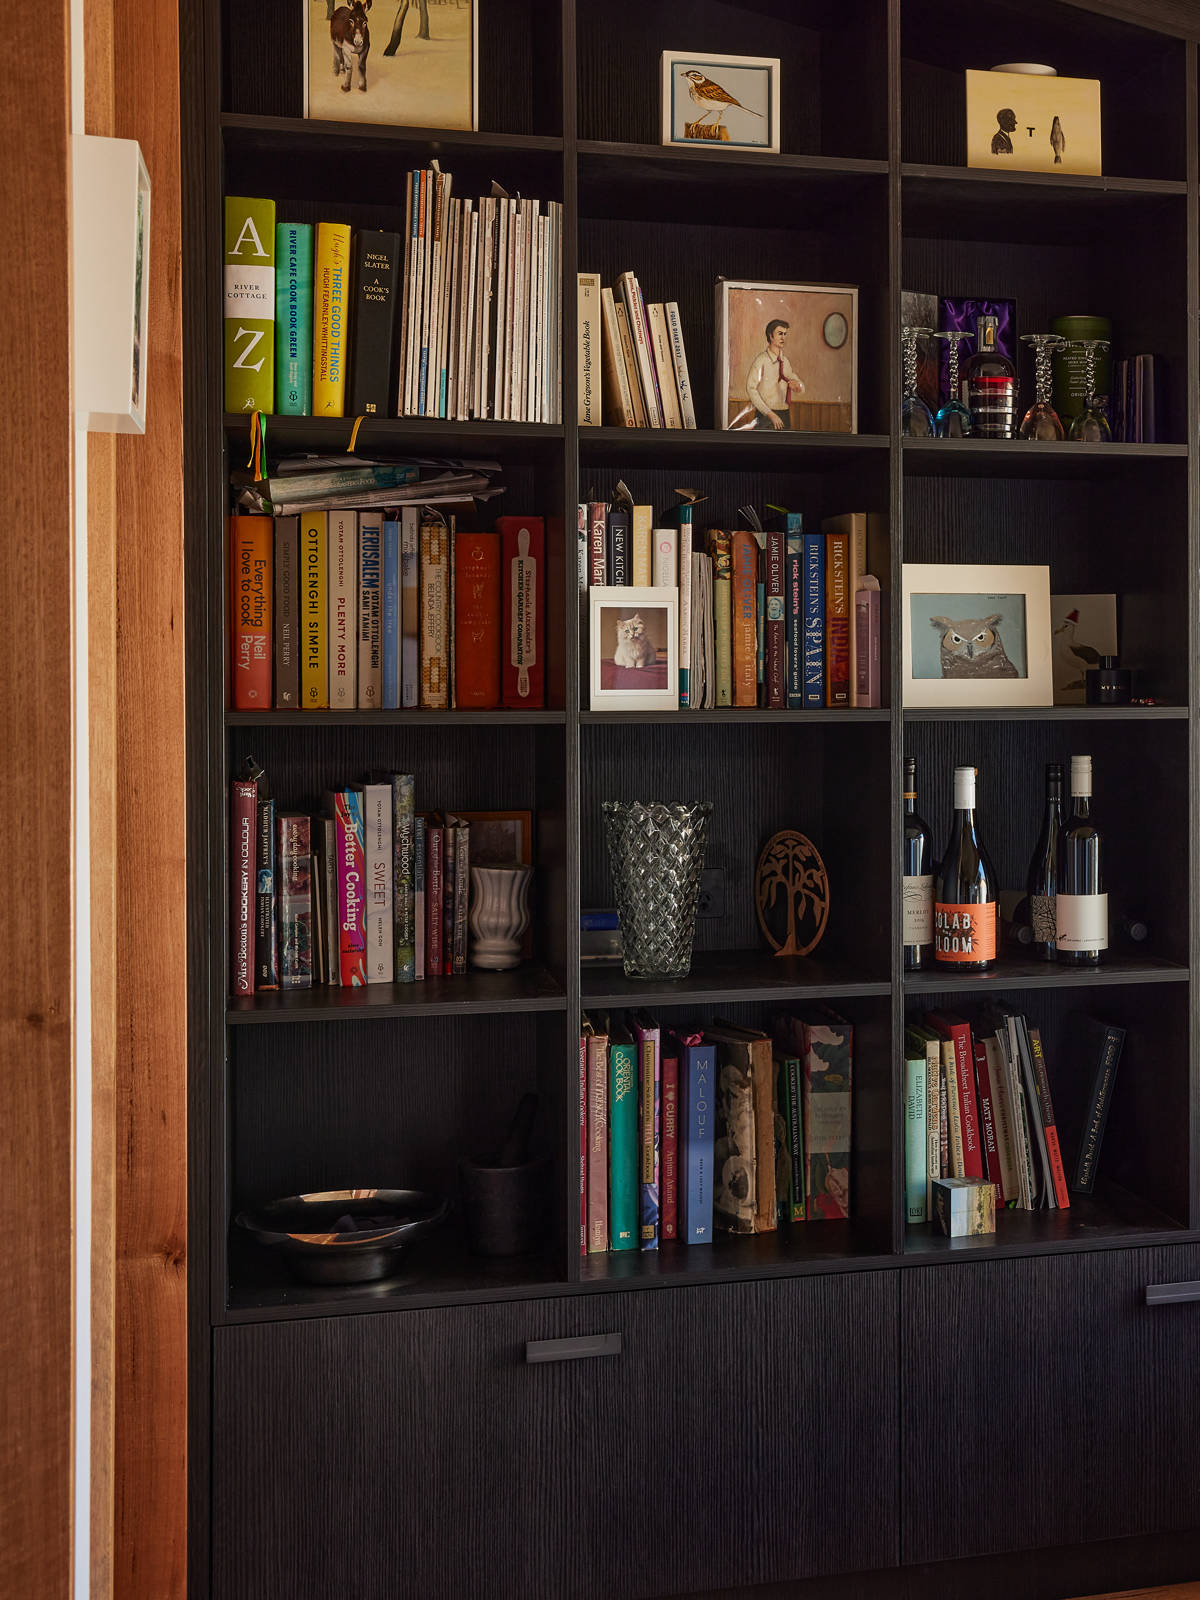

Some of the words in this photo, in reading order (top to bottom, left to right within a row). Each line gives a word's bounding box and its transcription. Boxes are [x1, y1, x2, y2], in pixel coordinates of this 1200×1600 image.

[1026, 127, 1036, 137] T
[228, 217, 271, 257] A
[289, 229, 298, 254] RIVER
[330, 233, 345, 265] Hugh's
[289, 257, 298, 278] CAFE
[364, 261, 391, 270] SLATER
[367, 253, 389, 262] NIGEL
[234, 284, 261, 292] RIVER
[289, 280, 298, 303] COOK
[322, 267, 331, 288] HUGH
[332, 267, 343, 302] THREE
[364, 285, 390, 294] COOK'S
[374, 278, 380, 286] A
[227, 292, 267, 300] COTTAGE
[365, 294, 386, 302] BOOK
[289, 305, 298, 329] BOOK
[331, 305, 342, 338] GOOD
[583, 320, 591, 340] Book
[232, 326, 265, 373] Z
[289, 330, 298, 358] GREEN
[320, 290, 330, 382] FEARNLEY-WHITTINGSTALL
[330, 341, 341, 383] THINGS
[582, 340, 592, 372] Vegetable
[582, 373, 592, 406] Grigson's
[583, 406, 593, 424] Jane
[593, 520, 605, 554] Karen
[615, 529, 624, 553] NEW
[771, 536, 779, 562] JAMIE
[241, 549, 254, 575] love
[361, 525, 380, 589] JERUSALEM
[742, 543, 753, 577] JAMIE
[809, 544, 820, 569] RICK
[833, 541, 843, 569] RICK
[282, 570, 291, 594] GOOD
[308, 528, 319, 615] OTTOLENGHI
[771, 563, 779, 593] OLIVER
[792, 559, 800, 580] rick
[241, 578, 252, 592] to
[252, 560, 267, 628] Everything
[427, 583, 435, 611] BELINDA
[792, 581, 800, 615] stein's
[809, 571, 820, 614] STEIN'S
[833, 570, 844, 614] STEIN'S
[241, 595, 253, 627] cook
[282, 596, 291, 618] FOOD
[362, 590, 371, 610] SAMI
[371, 590, 380, 618] YOTAM
[742, 580, 753, 620] OLIVER
[283, 623, 292, 641] NEIL
[337, 598, 346, 641] PLENTY
[361, 613, 371, 641] TAMIMI
[427, 612, 435, 639] JEFFERY
[238, 635, 254, 671] Perry
[254, 635, 267, 660] Neil
[283, 642, 292, 667] PERRY
[308, 622, 319, 670] SIMPLE
[370, 619, 380, 670] OTTOLENGHI
[742, 622, 754, 660] jamie's
[805, 617, 824, 686] SPAIN
[830, 617, 849, 665] INDIA
[337, 644, 346, 676] MORE
[741, 664, 754, 688] italy
[791, 671, 799, 690] guide
[262, 806, 270, 833] MADHUR
[261, 834, 269, 866] JAFFREY'S
[344, 823, 358, 868] Better
[400, 824, 412, 875] Wychwood
[242, 860, 249, 870] IN
[241, 871, 249, 921] COOKERY
[374, 862, 386, 907] SWEET
[343, 871, 360, 932] Cooking
[236, 923, 249, 959] Beeton's
[957, 1034, 967, 1050] The
[615, 1051, 624, 1077] COOK
[623, 1057, 632, 1094] ORIENTAL
[958, 1050, 969, 1090] Broadsheet
[615, 1078, 625, 1102] BOOK
[789, 1065, 798, 1094] COOKERY
[695, 1059, 709, 1139] MALOUF
[908, 1095, 916, 1120] DAVID
[914, 1075, 923, 1119] ELIZABETH
[962, 1091, 972, 1114] Italian
[982, 1097, 992, 1121] MATT
[665, 1102, 675, 1138] CURRY
[965, 1115, 977, 1152] Cookbook
[985, 1123, 996, 1153] MORAN
[664, 1150, 675, 1177] Anjum
[666, 1178, 675, 1204] Anand
